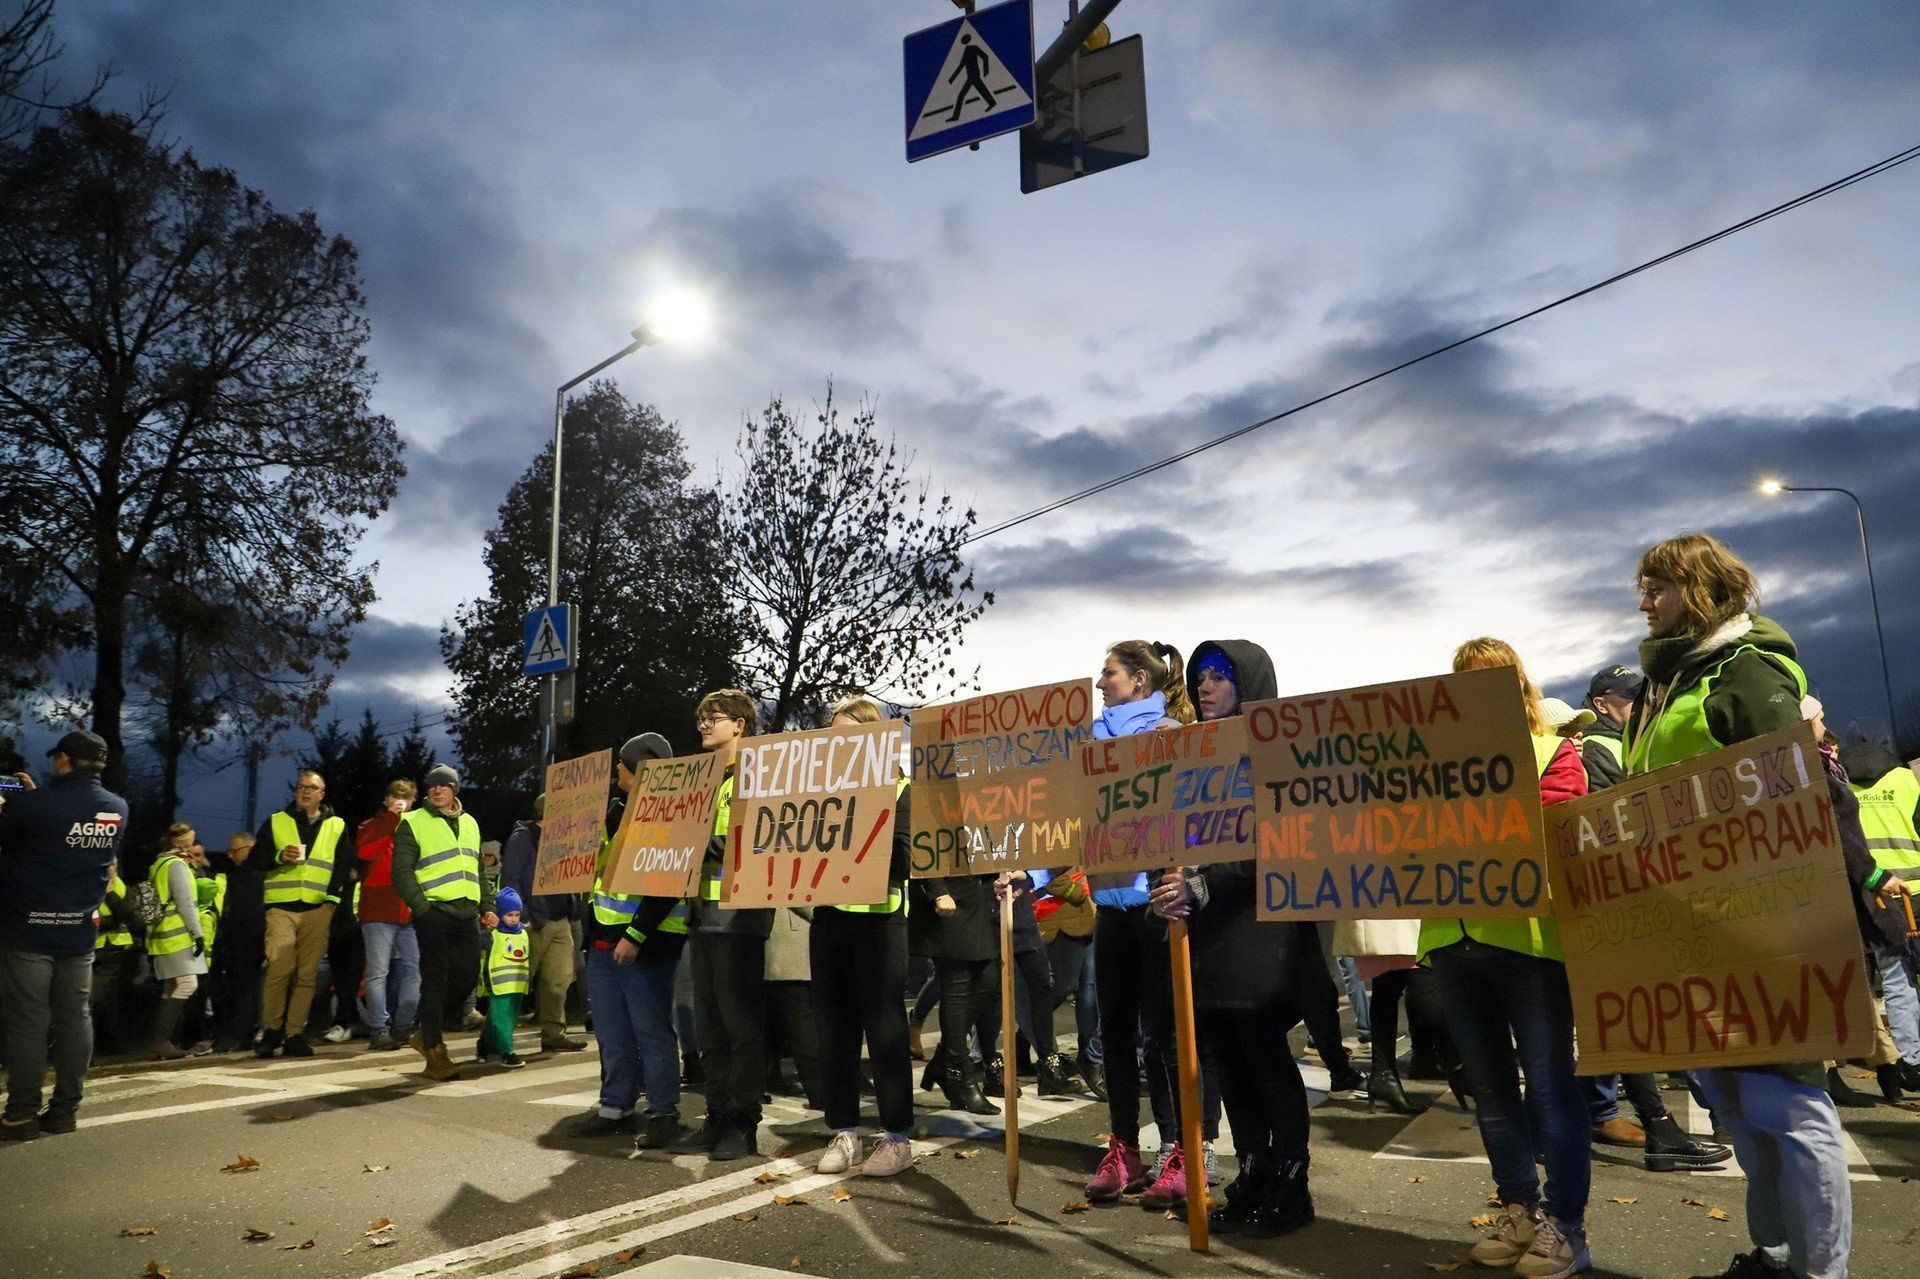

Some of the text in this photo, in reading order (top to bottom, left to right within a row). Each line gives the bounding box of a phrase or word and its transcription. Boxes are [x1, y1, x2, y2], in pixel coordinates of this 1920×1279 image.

[940, 686, 1089, 741] KIEROWCO
[1249, 679, 1461, 743] OSTATNIA
[640, 754, 716, 792] PISZEMY!
[738, 730, 902, 800] BEZPIECZNE
[912, 724, 1093, 780] PRZEPRASZAM
[1081, 722, 1220, 776] ILE WARTE
[1290, 726, 1430, 770] WIOSKA
[1097, 763, 1174, 824] JEST
[1265, 754, 1515, 813] TORUŃSKIEGO
[1555, 741, 1811, 858] MAŁEJ WIOSKI
[68, 822, 118, 837] AGRO
[80, 836, 114, 849] UNIA
[752, 795, 856, 854] DROGI
[911, 817, 1083, 871] SPRAWY MAM
[1084, 811, 1177, 867] NASZYCH
[1259, 799, 1532, 860] NIE WIDZIANA
[632, 846, 695, 873] ODMOWY
[1264, 853, 1542, 912] DLA KAŻDEGO
[1565, 834, 1693, 909] WIELKIE
[1594, 959, 1857, 1054] POPRAWY
